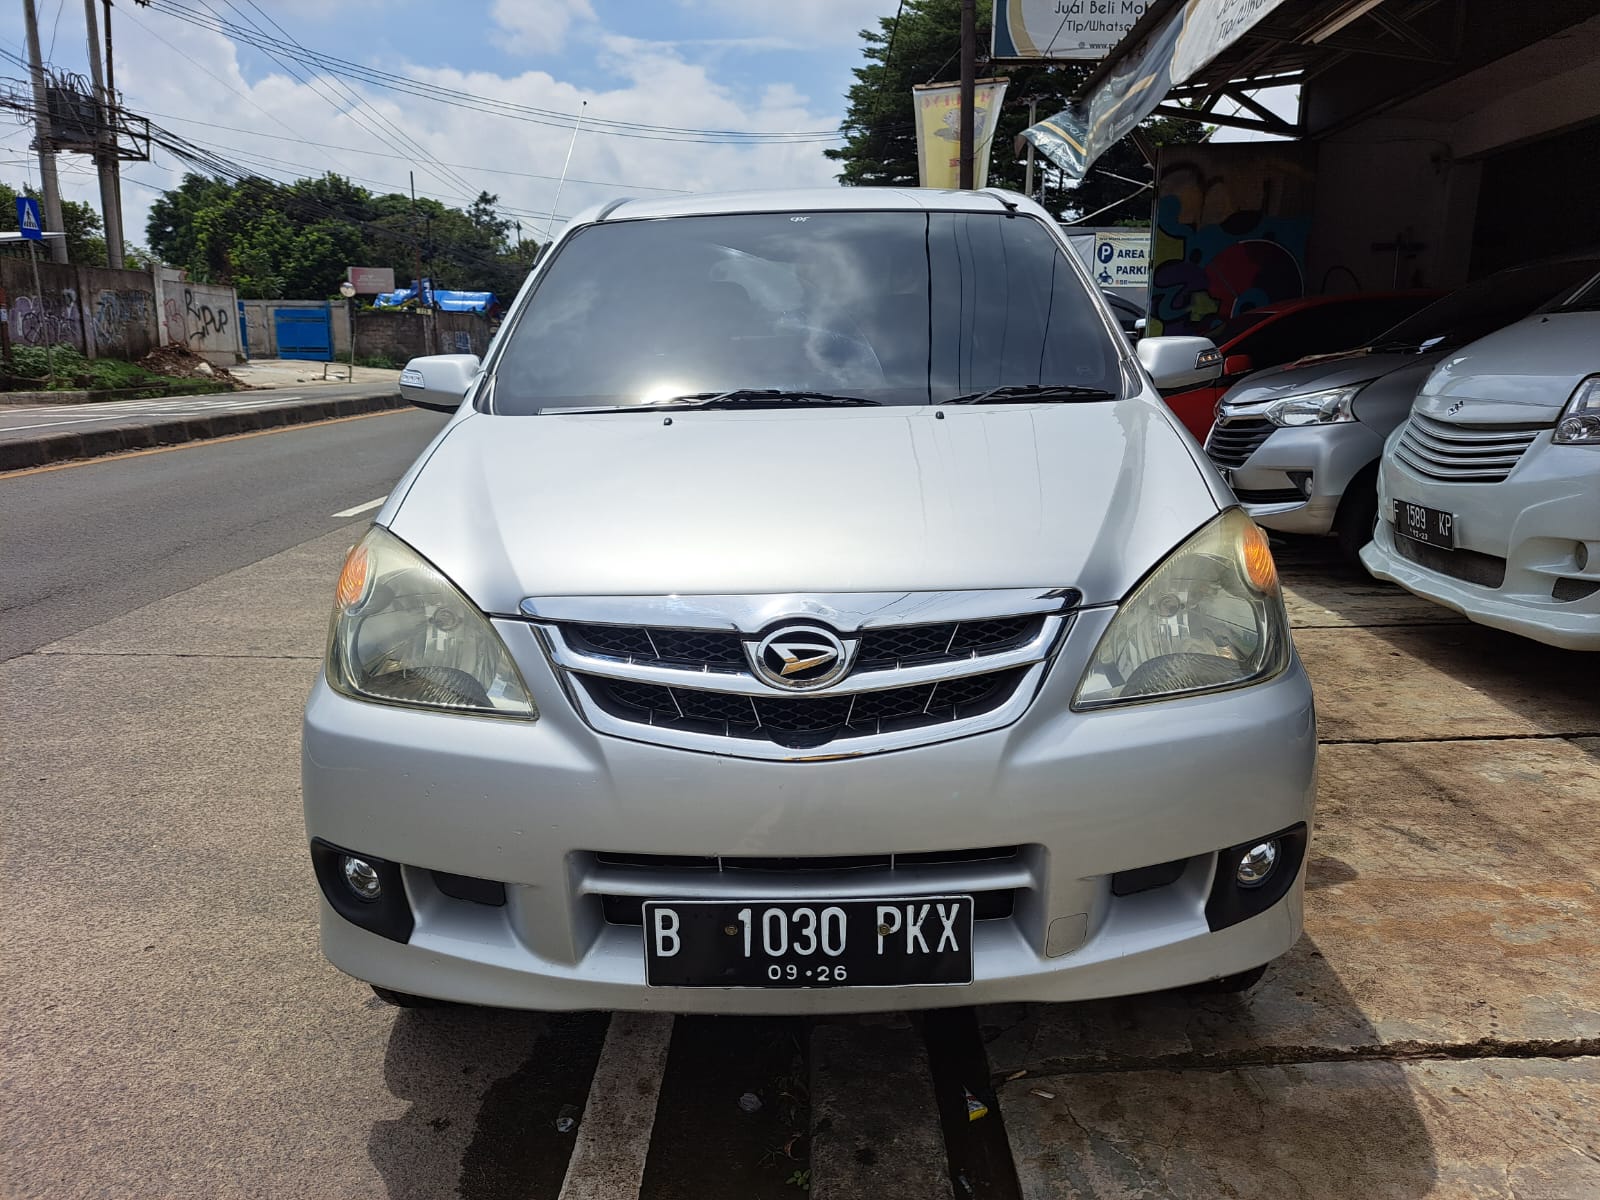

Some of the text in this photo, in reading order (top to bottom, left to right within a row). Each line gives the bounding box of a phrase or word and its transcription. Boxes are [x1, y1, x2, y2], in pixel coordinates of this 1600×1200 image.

[1055, 0, 1083, 14] Jual
[1090, 1, 1115, 14] Beli
[1117, 249, 1144, 258] AREA
[1406, 504, 1426, 529] 1589
[1439, 512, 1452, 536] KP
[654, 903, 960, 957] B 1030 PKX
